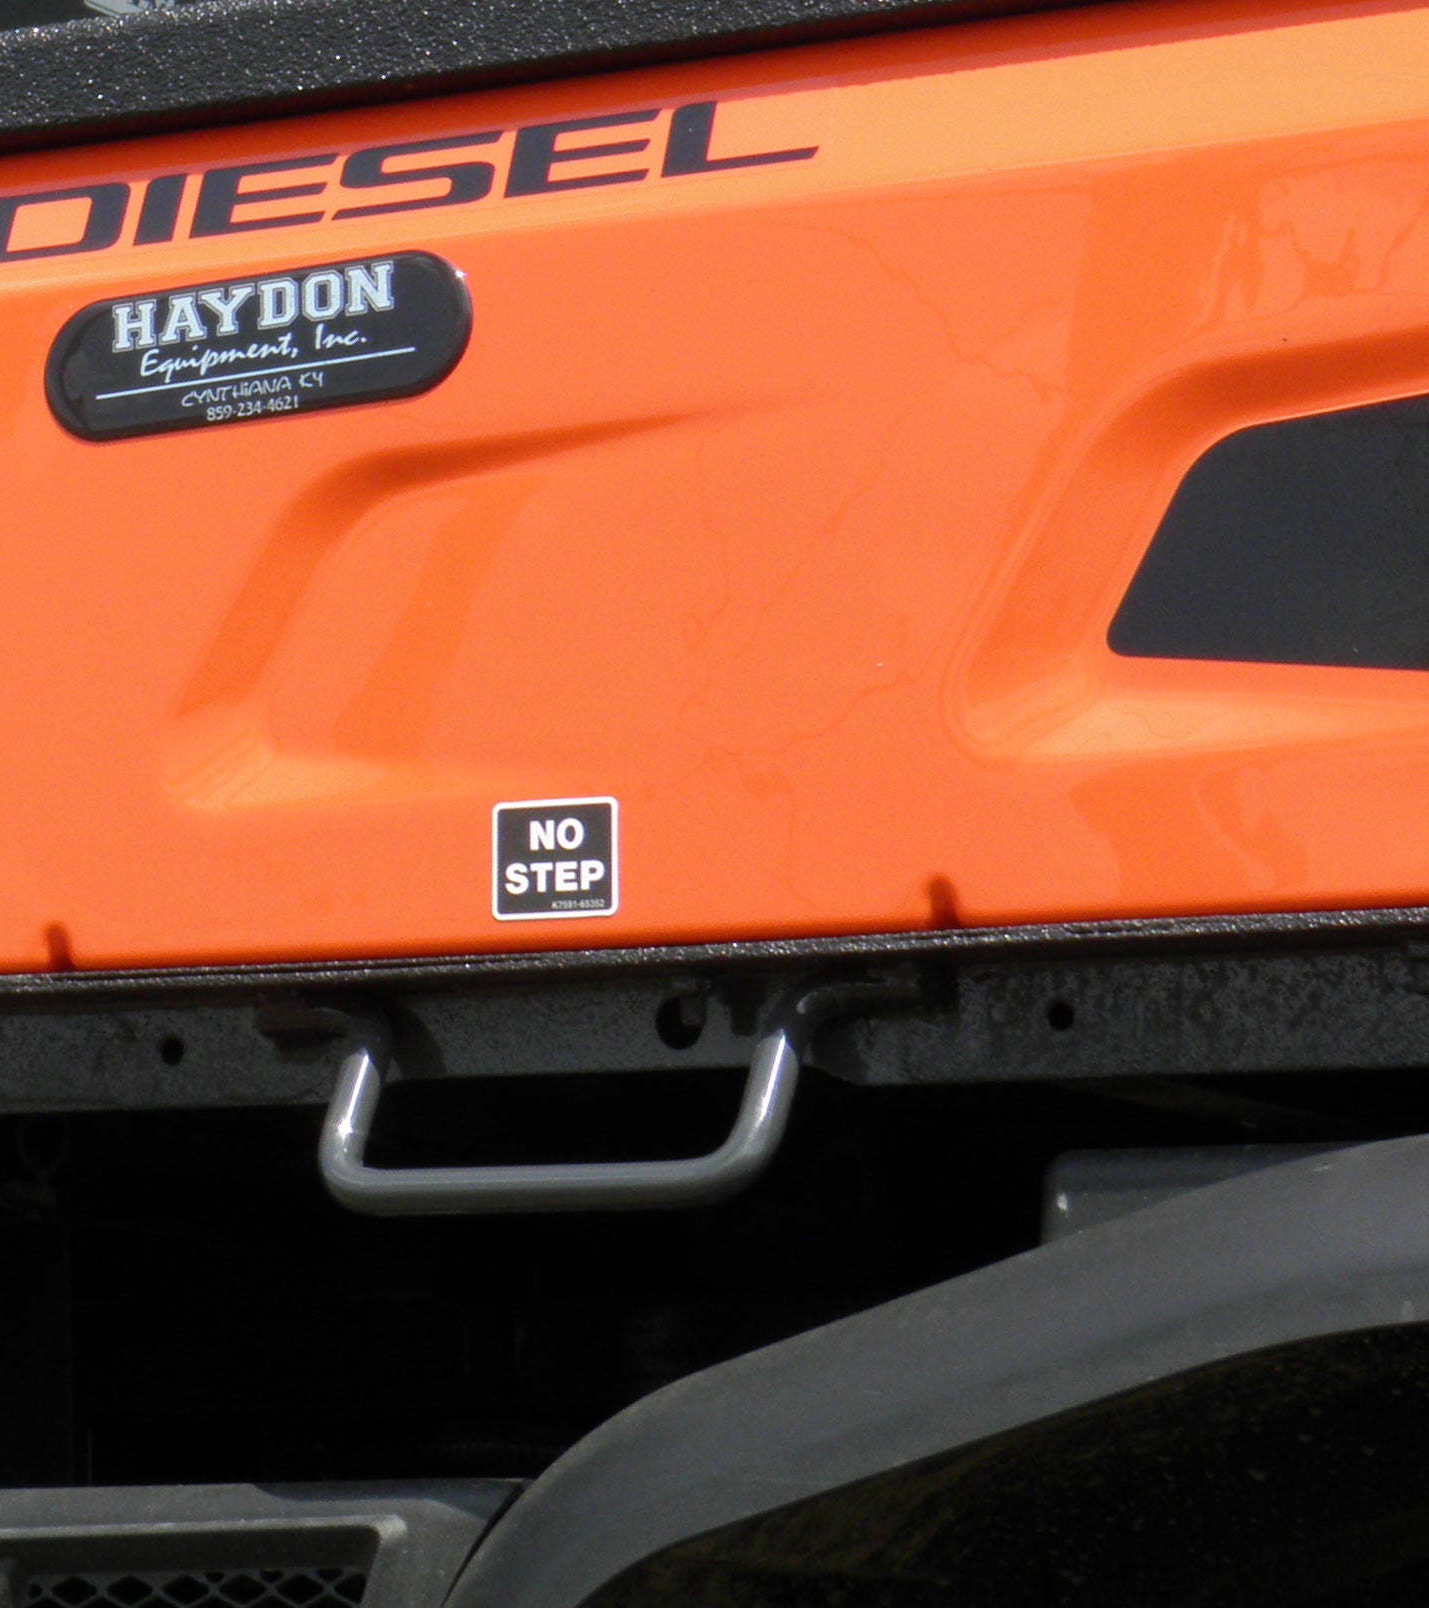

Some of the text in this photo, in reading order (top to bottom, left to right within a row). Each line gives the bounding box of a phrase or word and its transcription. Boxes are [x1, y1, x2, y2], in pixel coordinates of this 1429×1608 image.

[112, 260, 394, 353] HAYDON
[140, 323, 367, 383] Equipment, Inc.
[299, 371, 324, 388] KY
[206, 395, 300, 422] 859-234-4621
[530, 817, 585, 851] NO
[505, 859, 605, 895] STEP
